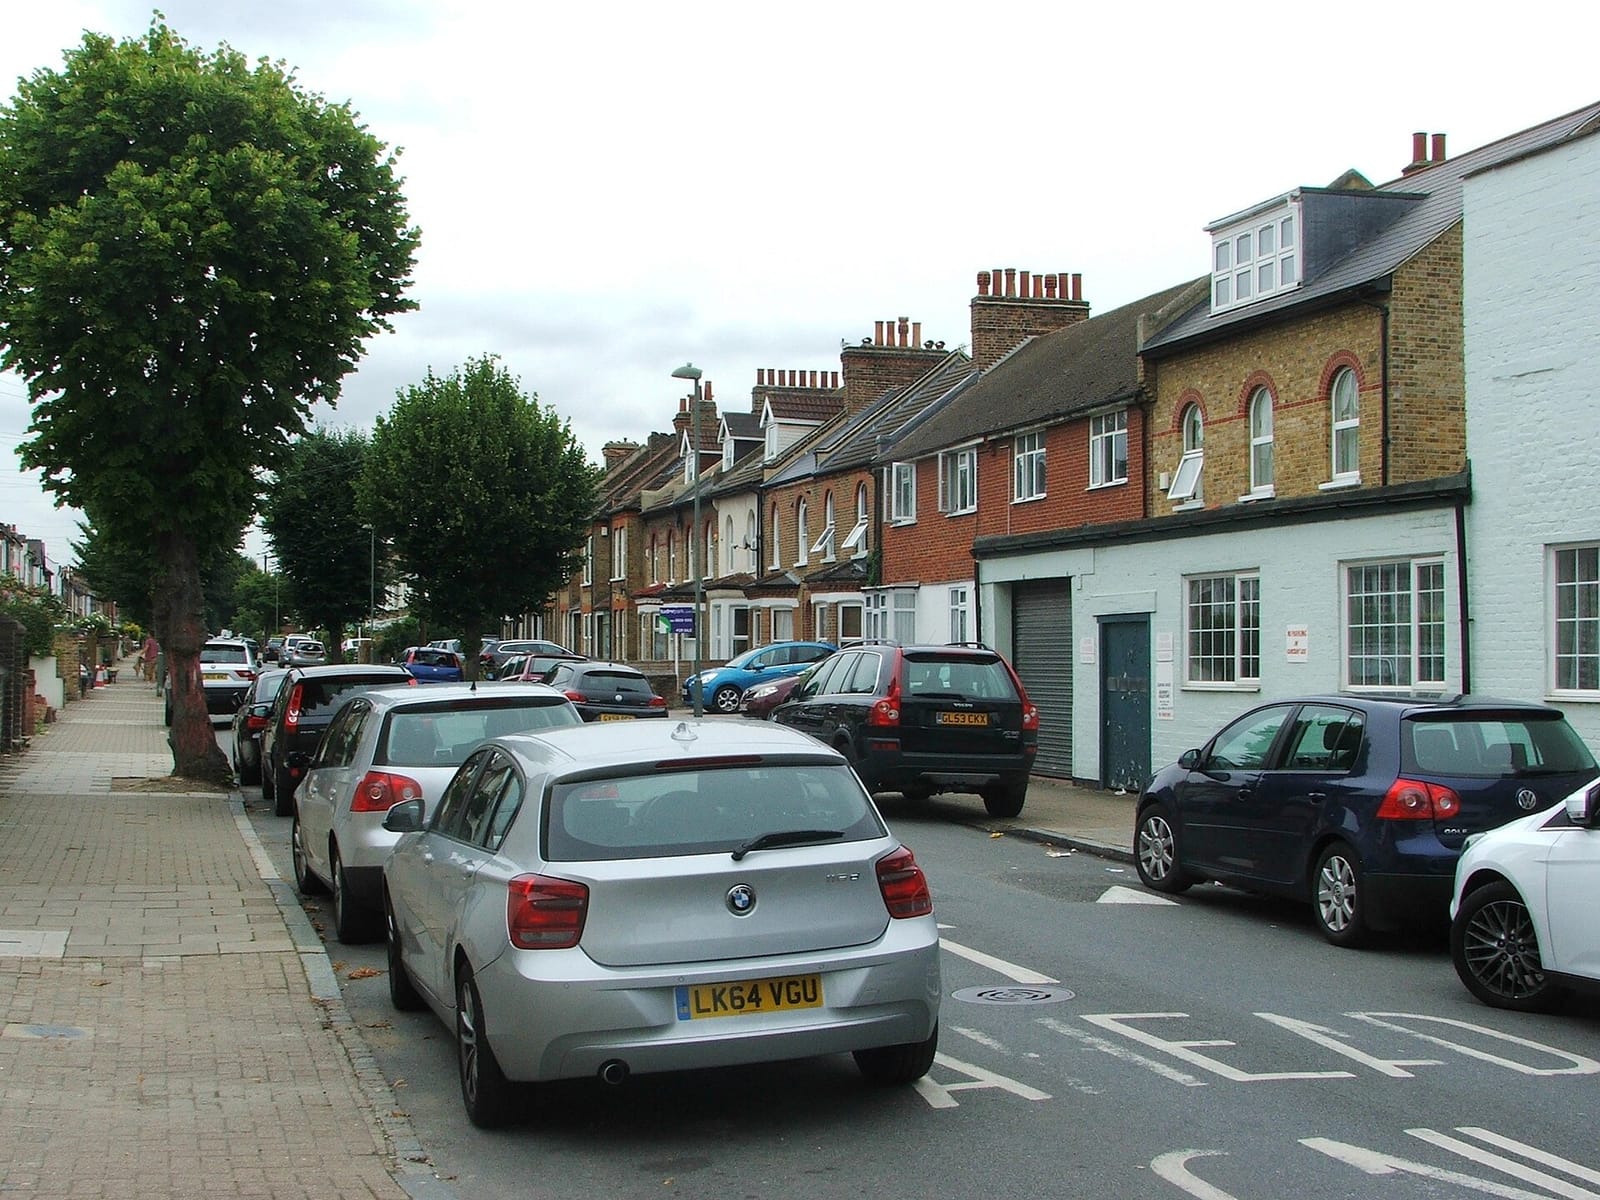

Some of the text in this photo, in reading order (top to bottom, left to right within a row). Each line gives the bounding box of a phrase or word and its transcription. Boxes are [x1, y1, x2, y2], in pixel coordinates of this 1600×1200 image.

[942, 713, 986, 724] GL53 CKX
[694, 983, 762, 1014] LK64
[769, 980, 817, 1006] VGU
